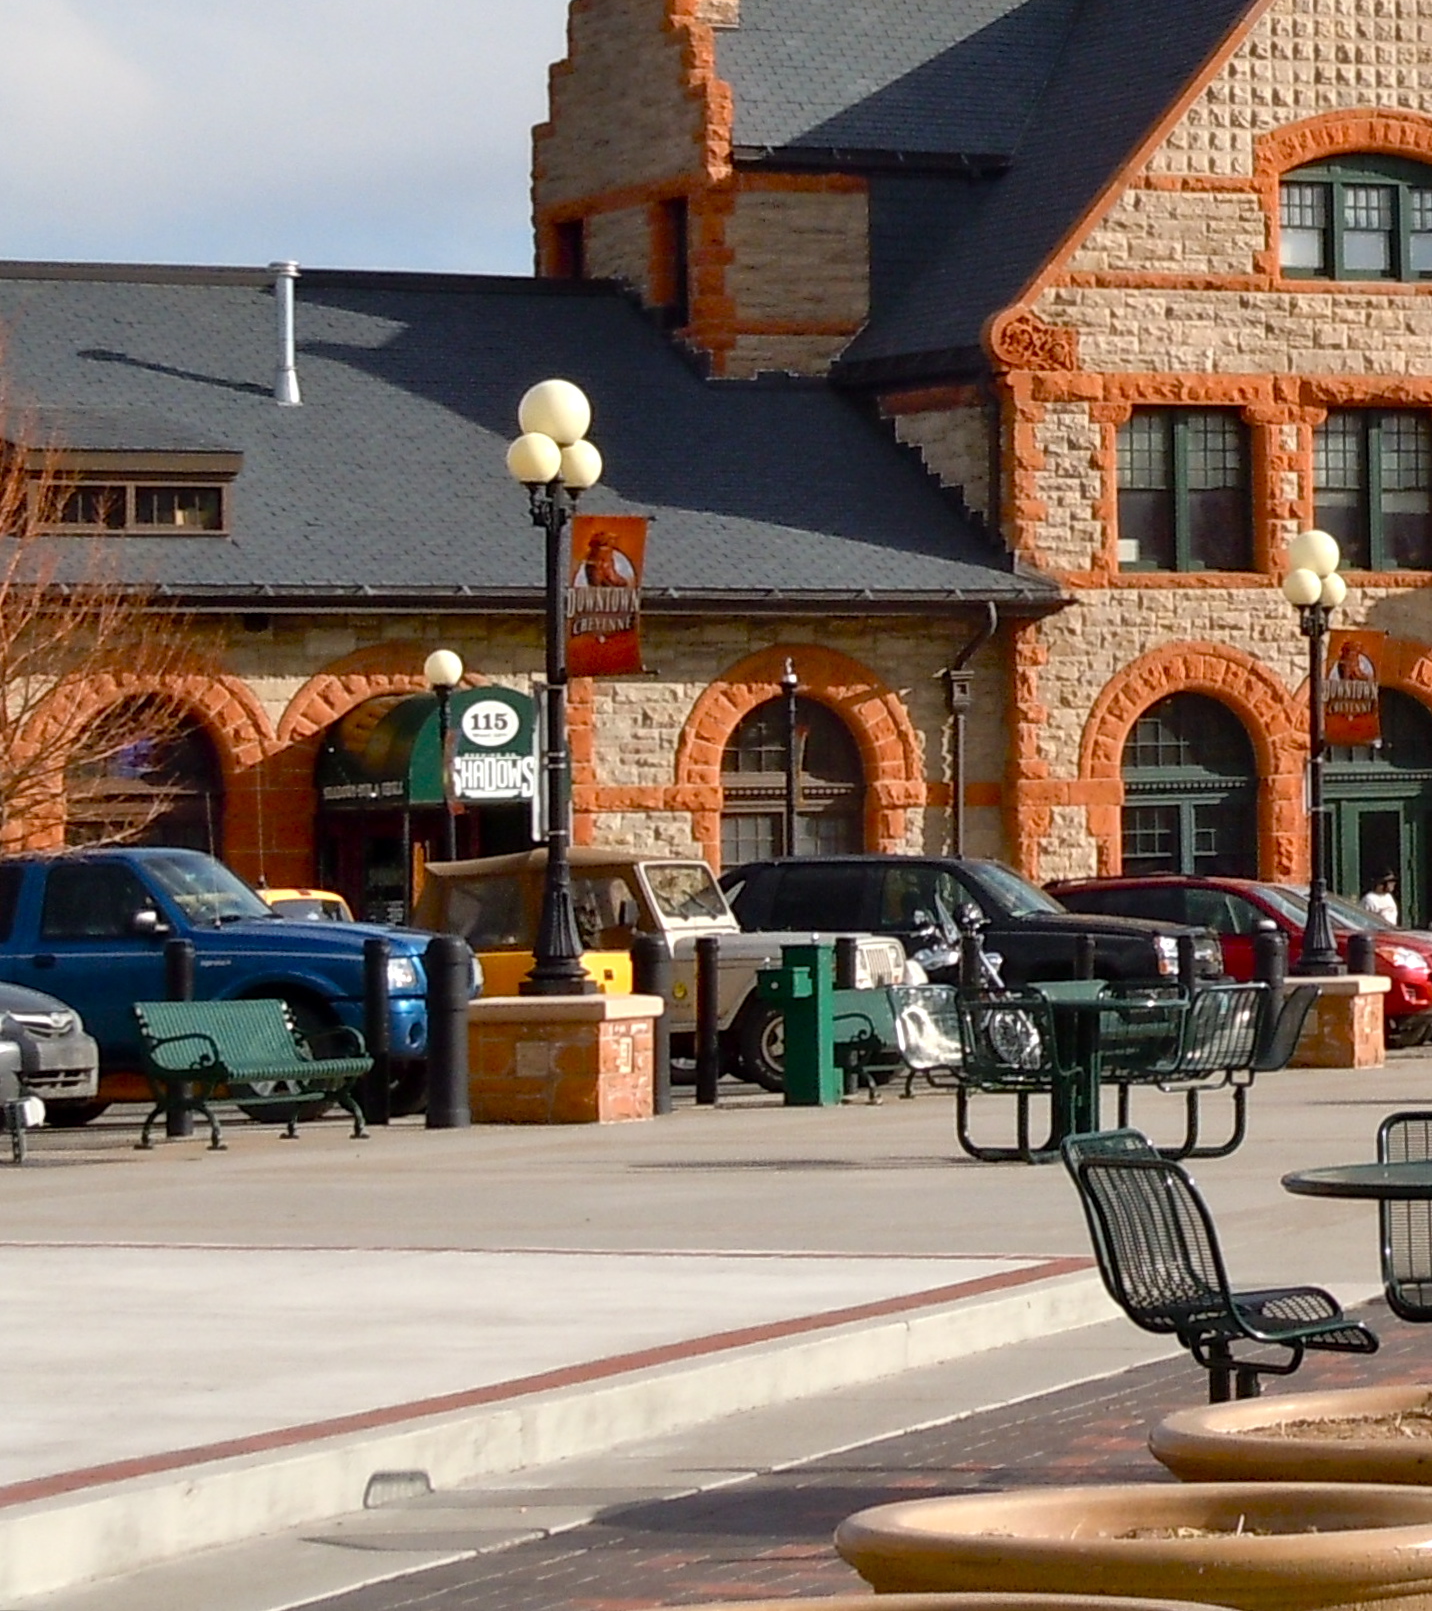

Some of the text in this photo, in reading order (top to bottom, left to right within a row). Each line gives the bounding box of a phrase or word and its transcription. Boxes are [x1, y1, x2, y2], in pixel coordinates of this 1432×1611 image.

[566, 587, 640, 618] DOWNTOWN
[470, 713, 508, 730] 115
[453, 756, 535, 797] SHADOWS
